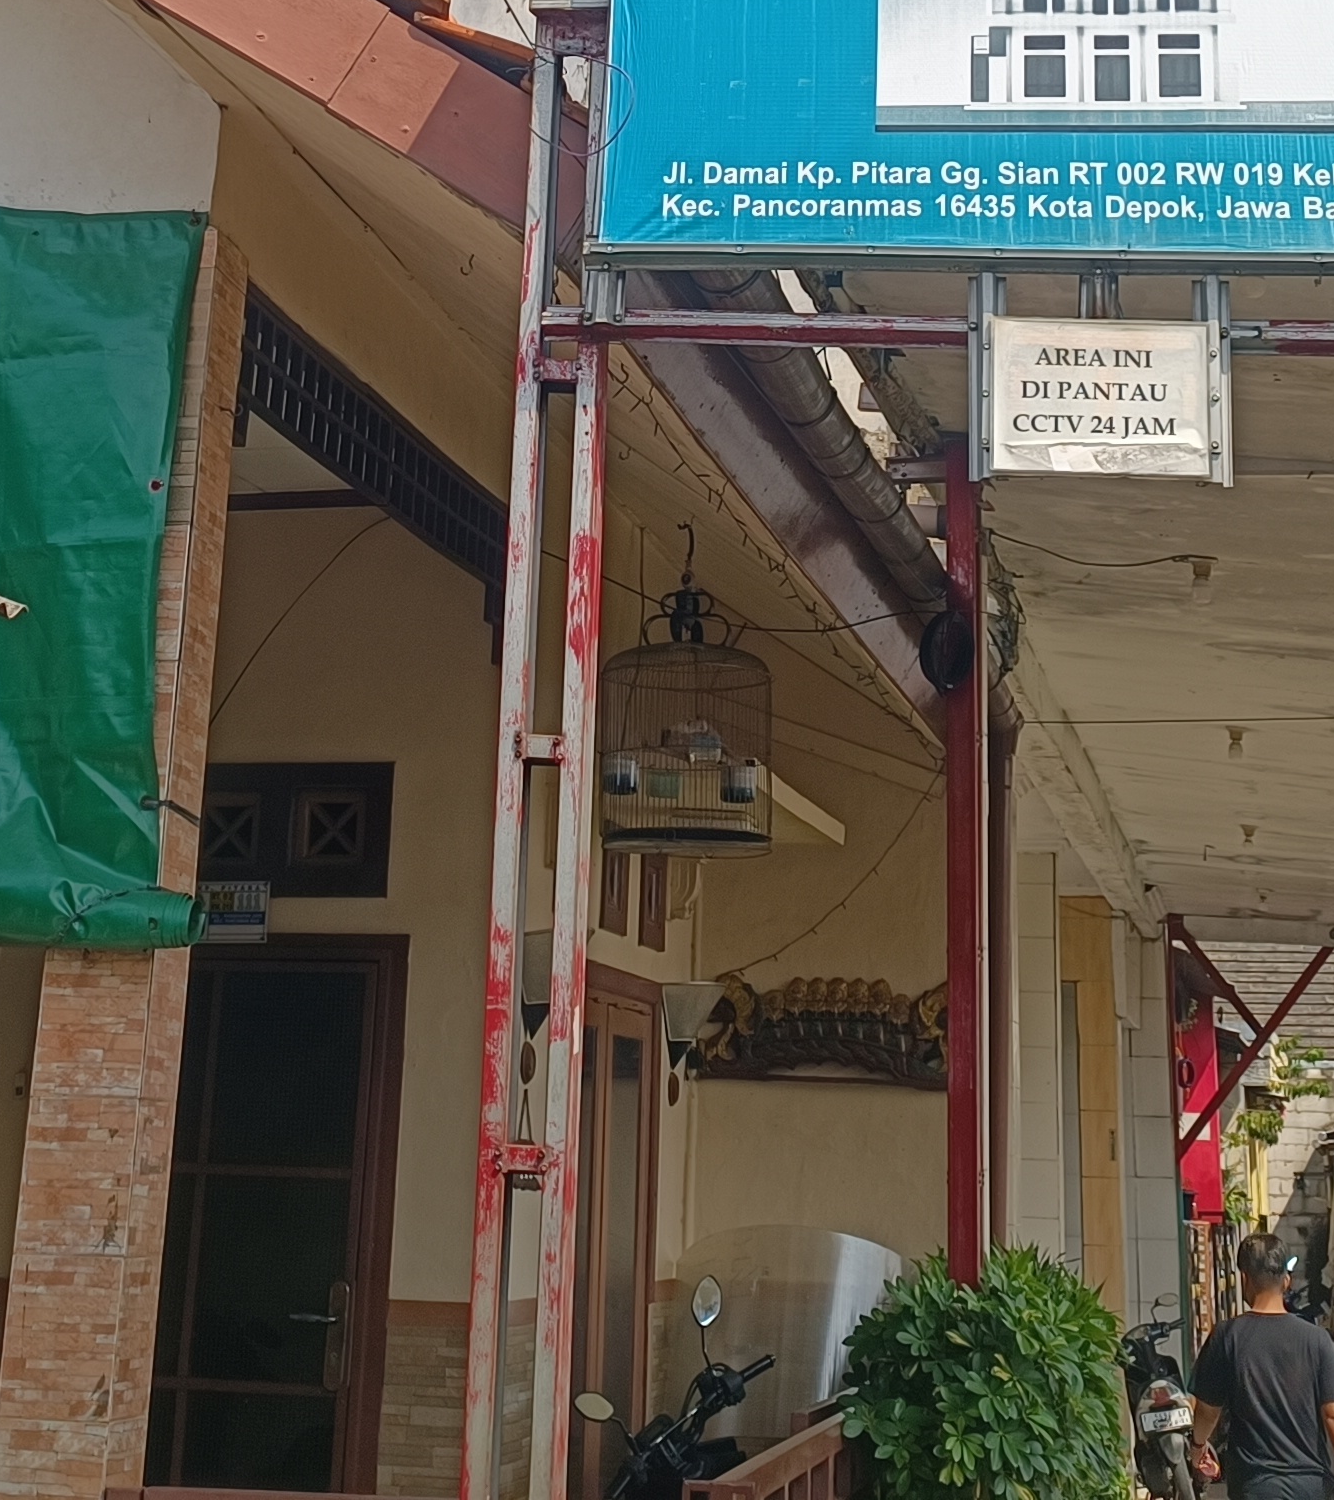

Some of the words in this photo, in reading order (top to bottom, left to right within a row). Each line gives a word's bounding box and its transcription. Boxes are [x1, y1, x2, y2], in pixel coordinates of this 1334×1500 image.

[663, 162, 693, 184] Jl.
[703, 162, 788, 184] Damai
[797, 162, 841, 189] Kp.
[852, 162, 931, 184] Pitara
[940, 162, 988, 190] Gg.
[998, 162, 1059, 185] Sian
[1069, 162, 1108, 185] RT
[1117, 162, 1166, 186] 002
[1176, 163, 1225, 185] RW
[1233, 163, 1283, 186] 019
[662, 194, 720, 217] Kec.
[733, 195, 922, 217] Pancoranmas
[935, 194, 1016, 218] 16435
[1028, 195, 1093, 218] Kota
[1105, 196, 1204, 224] Depok,
[1216, 196, 1291, 219] Jawa
[1035, 348, 1106, 367] AREA
[1113, 349, 1153, 368] INI
[1021, 380, 1050, 399] DI
[1057, 381, 1168, 402] PANTAU
[1013, 414, 1084, 433] CCTV
[1090, 416, 1116, 434] 24
[1121, 416, 1177, 439] JAM
